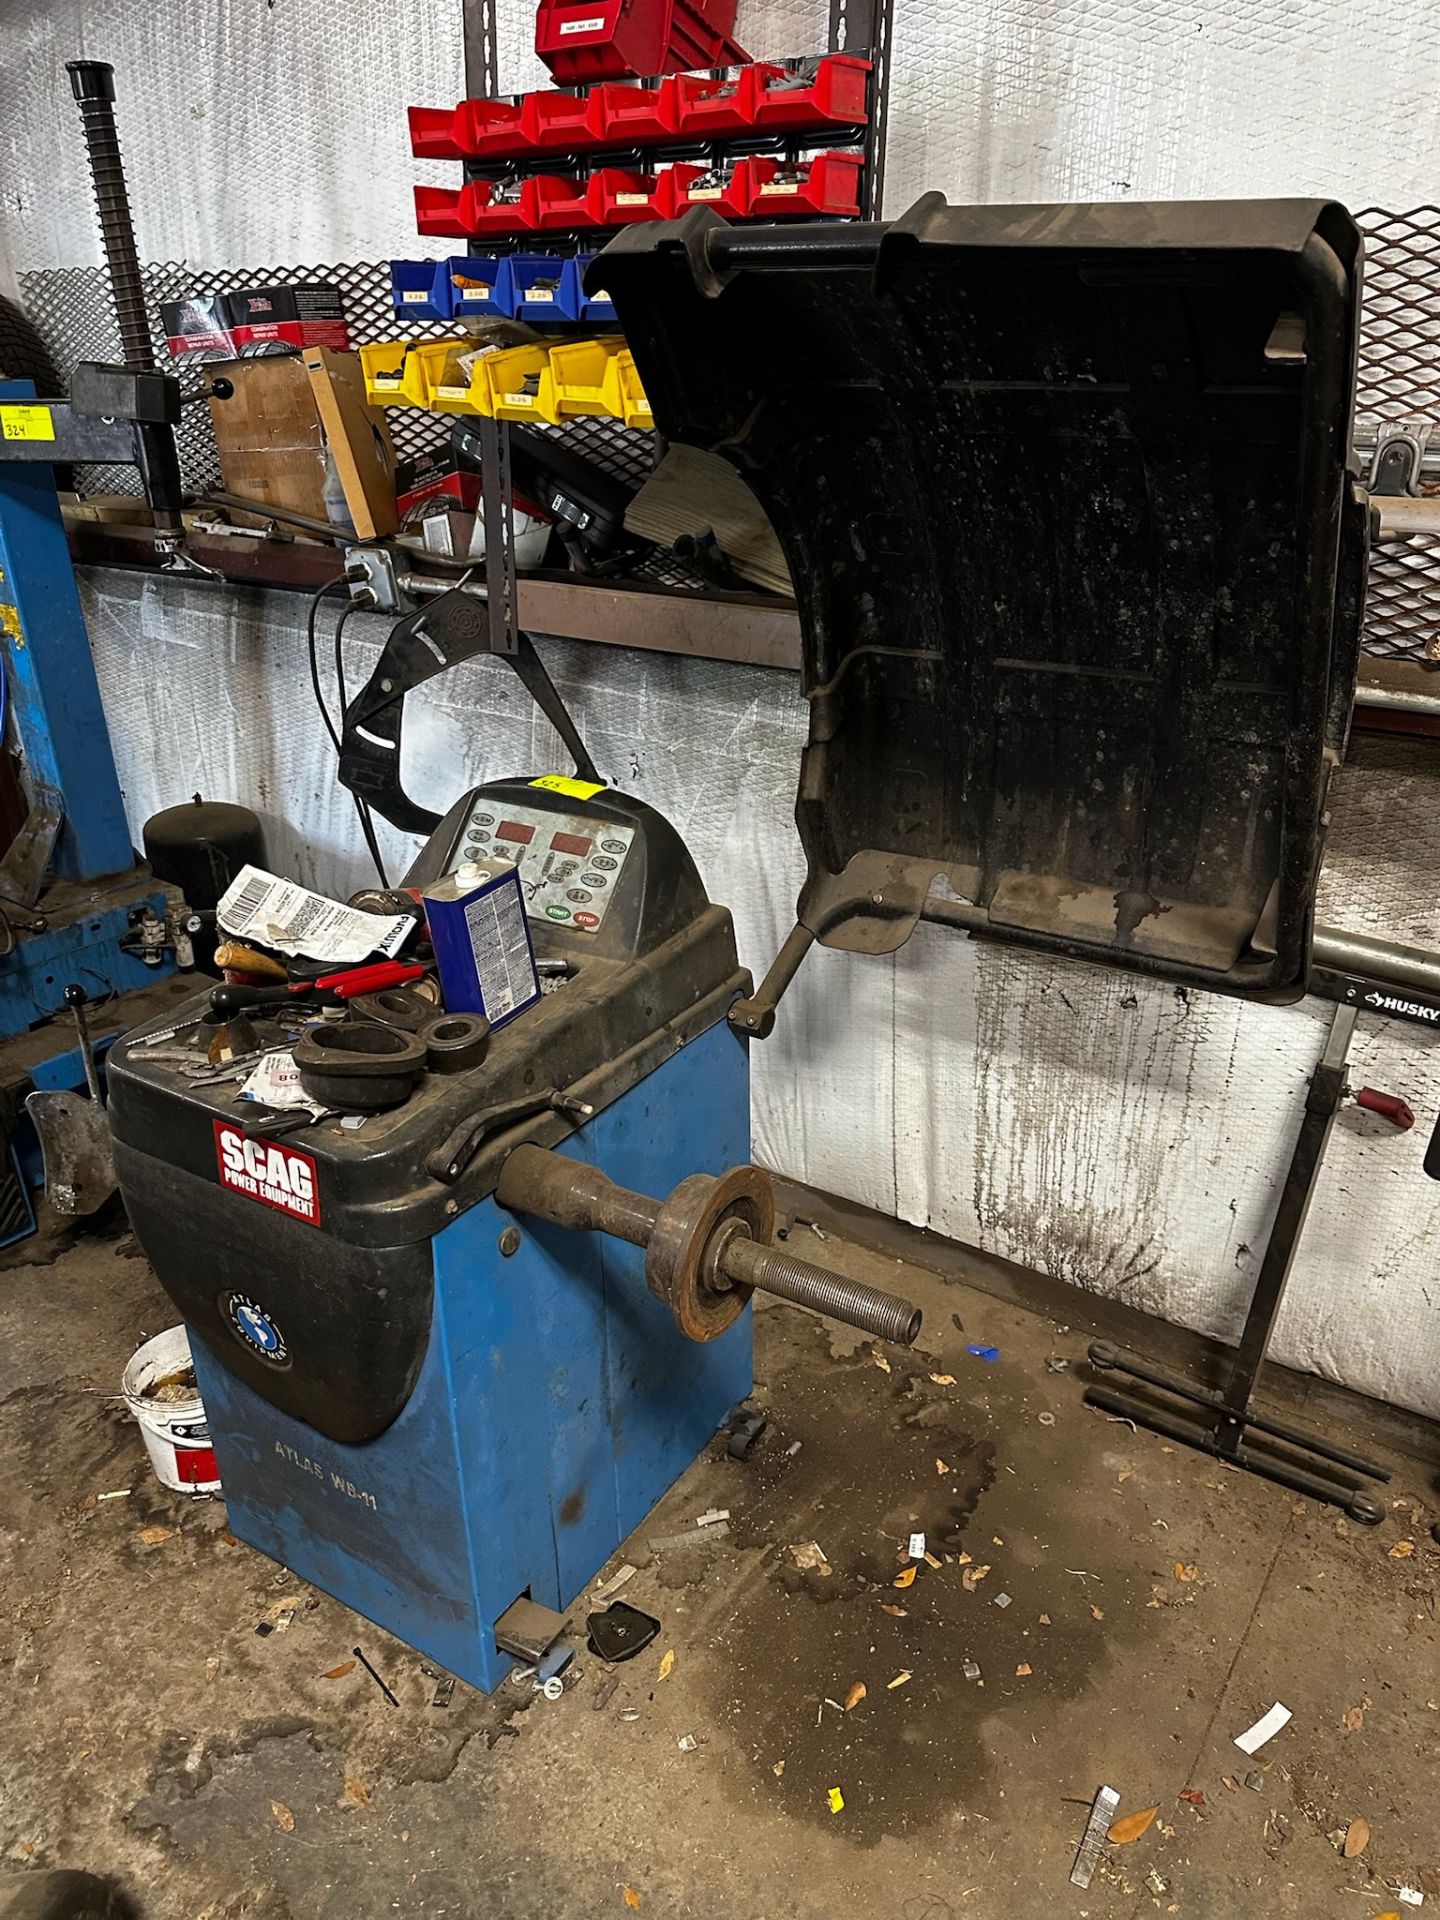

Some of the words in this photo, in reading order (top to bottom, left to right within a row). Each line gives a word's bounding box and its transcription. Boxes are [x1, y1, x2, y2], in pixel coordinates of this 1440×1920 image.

[5, 424, 27, 437] 324
[548, 907, 569, 917] START
[577, 914, 596, 924] STOP
[1383, 996, 1440, 1021] HUSKY
[220, 1129, 314, 1201] SCAG
[223, 1166, 258, 1195] POWER
[259, 1181, 314, 1218] EQUIPMENT
[232, 1294, 272, 1323] ATLAS
[275, 1440, 325, 1480] ATLAS
[330, 1472, 378, 1511] WB-11
